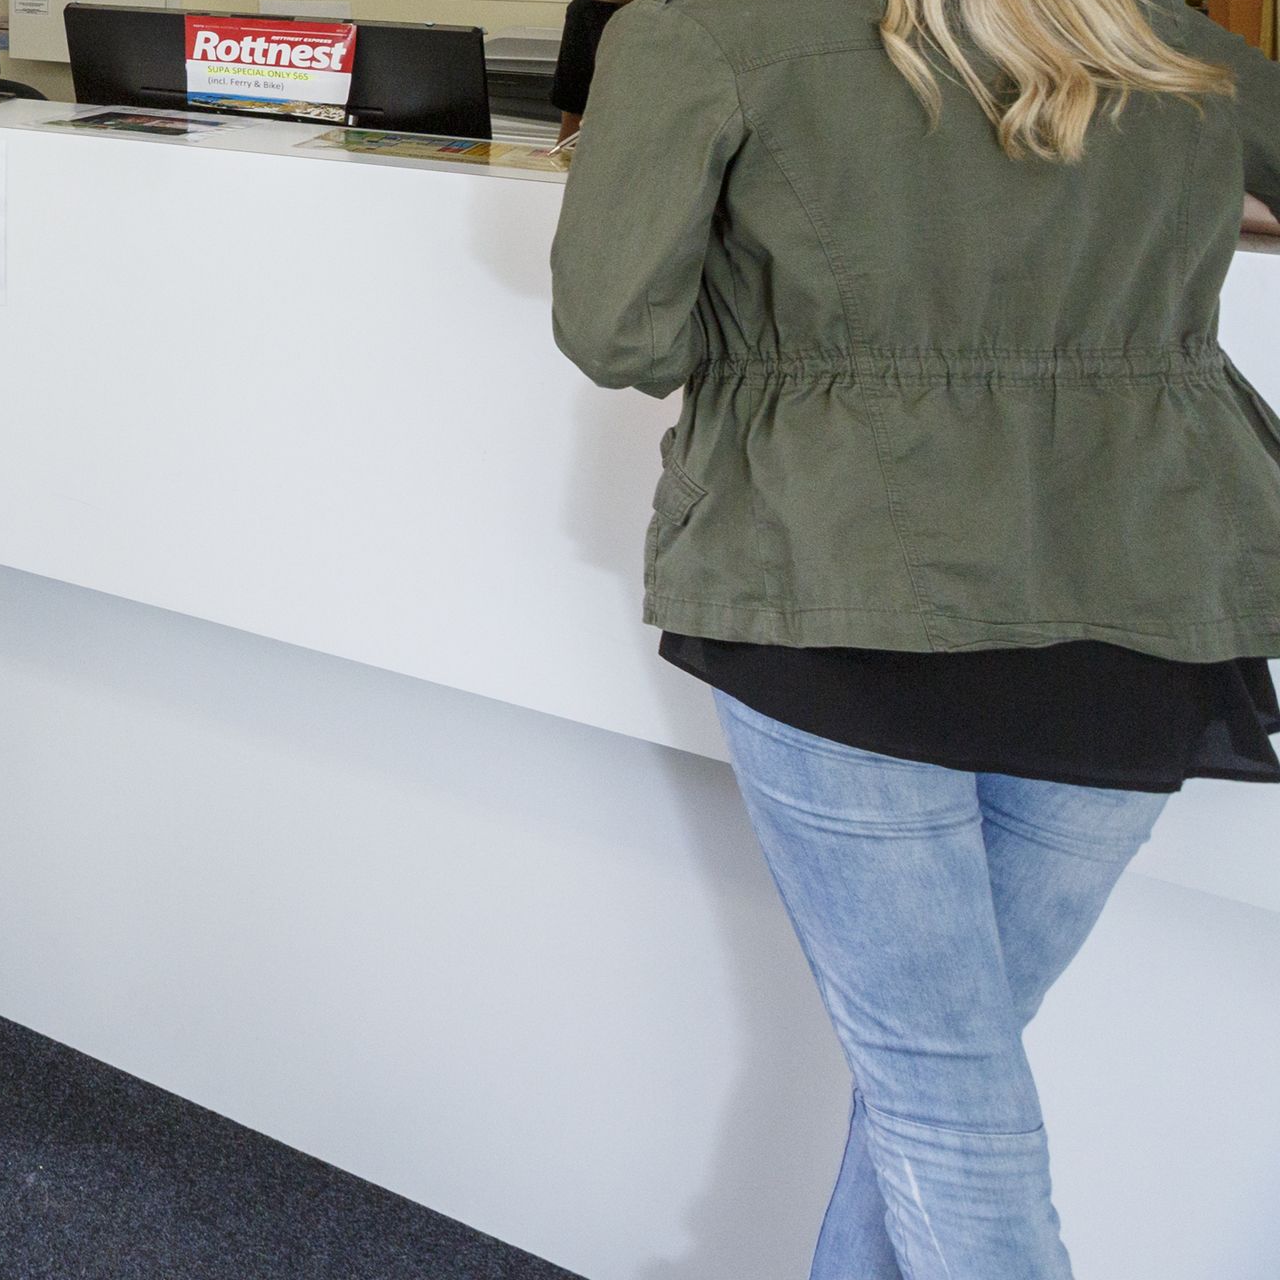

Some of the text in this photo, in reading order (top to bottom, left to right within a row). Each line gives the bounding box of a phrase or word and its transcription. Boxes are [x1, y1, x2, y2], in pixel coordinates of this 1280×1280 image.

[303, 36, 333, 45] EXPRESS
[192, 29, 348, 71] Rottnest
[207, 65, 230, 74] SUPA
[231, 66, 266, 78] SPECIAL
[267, 70, 291, 80] ONLY
[207, 76, 285, 93] (incl. Ferry & Bike)
